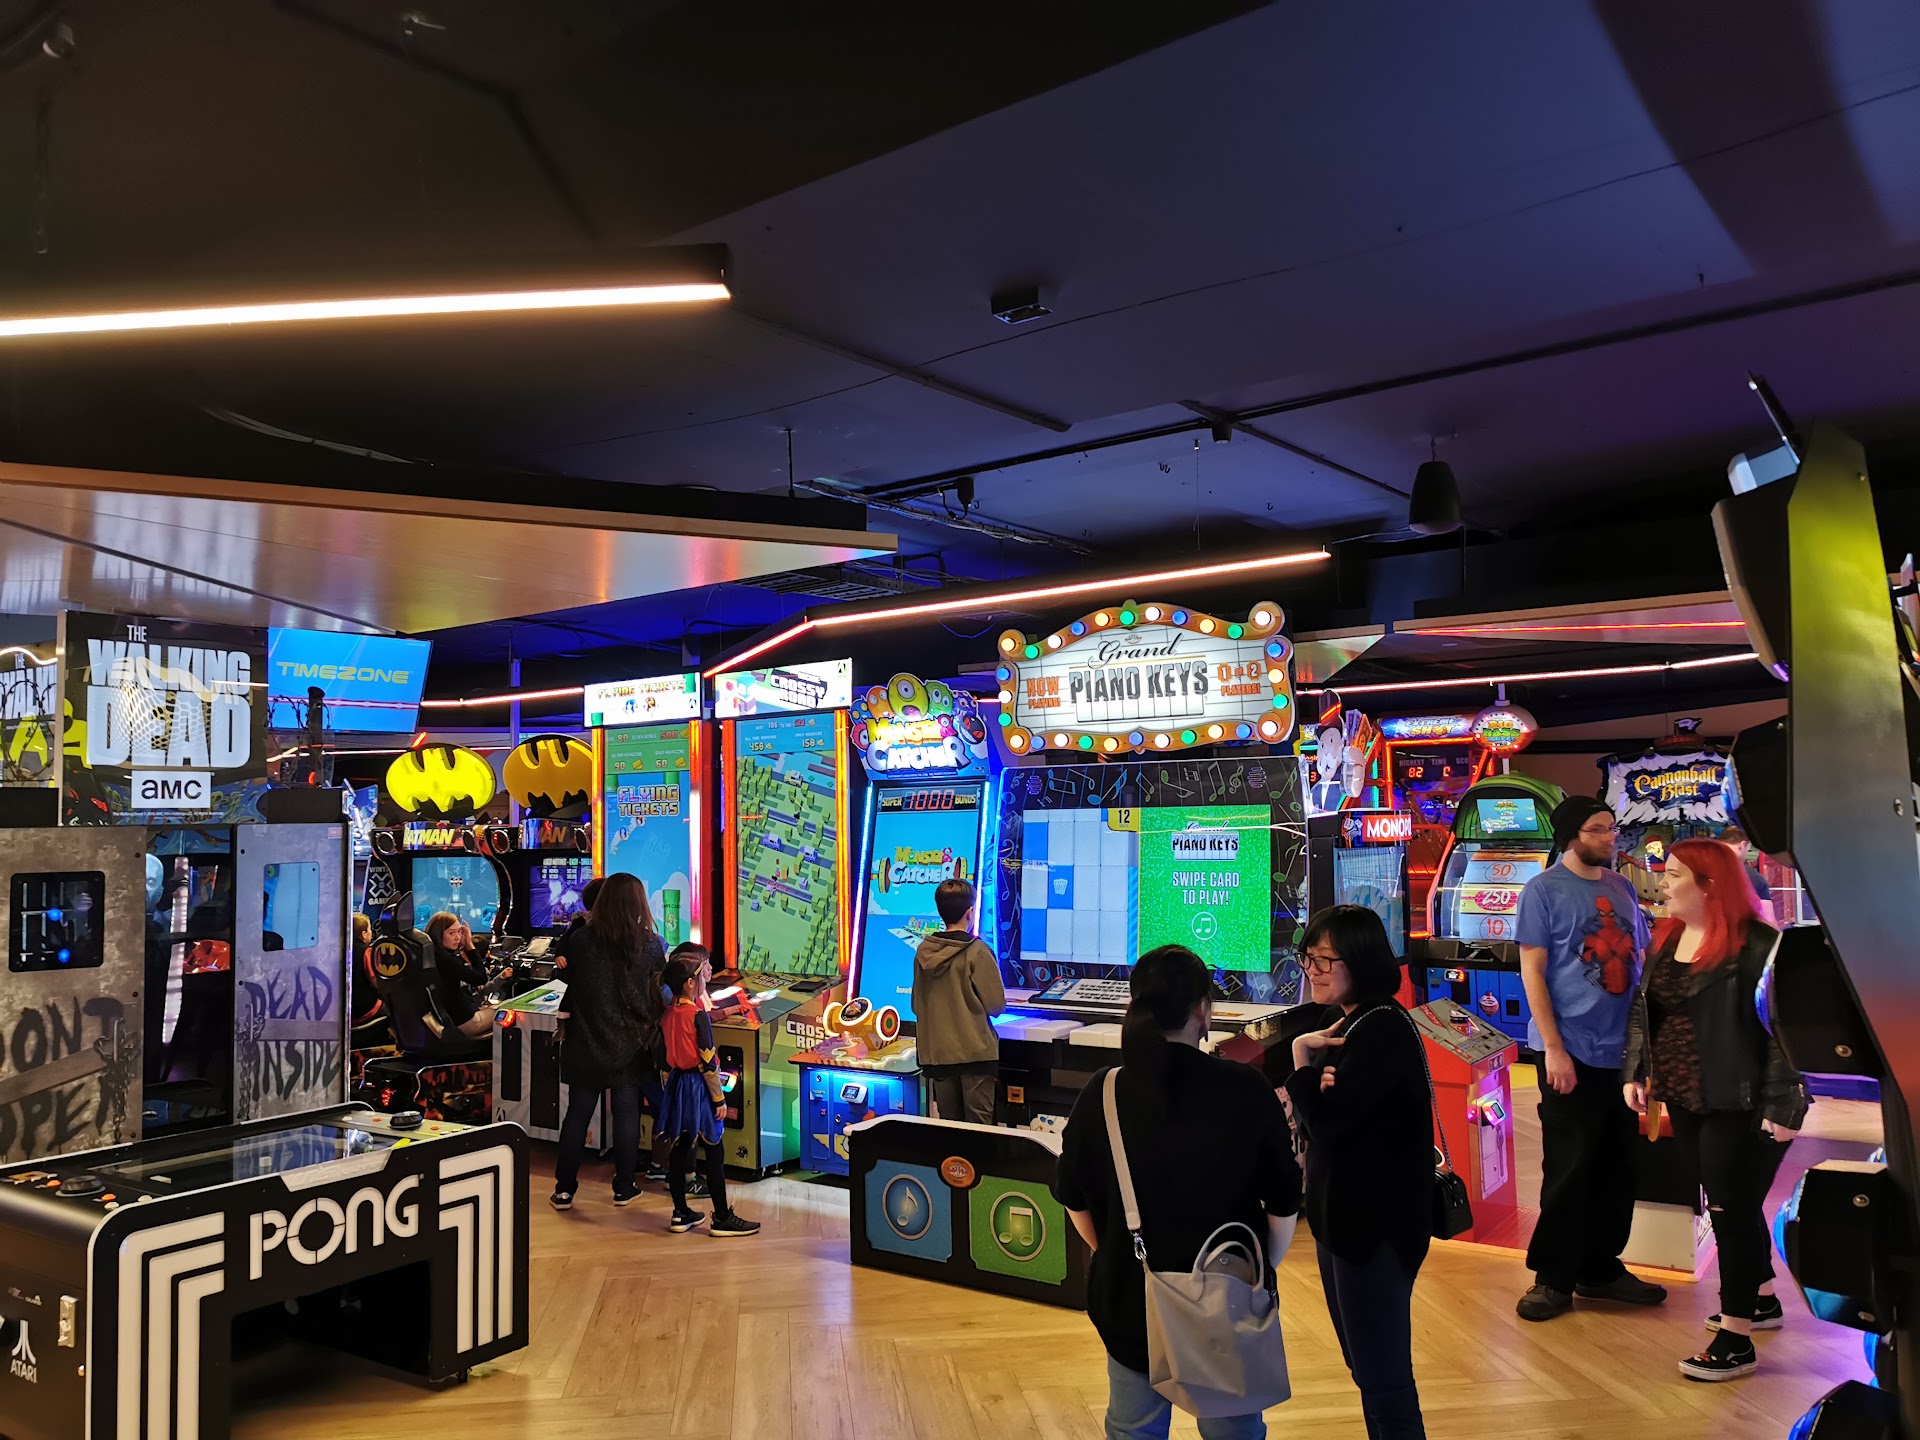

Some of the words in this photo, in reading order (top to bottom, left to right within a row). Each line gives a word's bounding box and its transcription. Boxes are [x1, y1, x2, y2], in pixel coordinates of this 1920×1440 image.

[127, 624, 147, 642] THE
[1087, 632, 1183, 669] Grand
[87, 638, 251, 695] WALKING
[276, 661, 410, 685] TIMEZONE
[598, 685, 636, 699] FLYING
[640, 680, 685, 694] TICKETS
[770, 674, 827, 700] CROSSY
[1027, 675, 1060, 697] NOW
[1069, 664, 1141, 704] PIANO
[1146, 660, 1209, 698] KEYS
[1221, 683, 1261, 696] PLAYERS!
[86, 685, 251, 768] DEAD
[1408, 766, 1424, 778] 82
[1632, 763, 1724, 798] Cannonball
[618, 785, 679, 802] FLYING
[908, 789, 955, 811] 1000
[954, 794, 977, 805] BONUS
[1660, 782, 1702, 802] Blast
[619, 801, 679, 817] TICKETS
[1118, 809, 1131, 824] 12
[403, 827, 455, 846] BATMAN
[1172, 834, 1206, 851] PIANO
[1210, 834, 1239, 851] KEYS
[888, 861, 956, 884] CATCHER
[1172, 872, 1206, 887] SWIPE
[1210, 872, 1240, 887] CARD
[1491, 863, 1512, 877] 50
[1182, 890, 1196, 905] TO
[1199, 890, 1230, 905] PLAY!
[1481, 887, 1512, 906] 250
[1486, 918, 1505, 937] 10
[244, 966, 333, 1021] DEAD
[0, 996, 124, 1073] ONT
[786, 1019, 830, 1039] CROS
[797, 1034, 823, 1049] RO
[249, 1174, 420, 1281] PONG
[10, 1359, 38, 1383] ATARI
